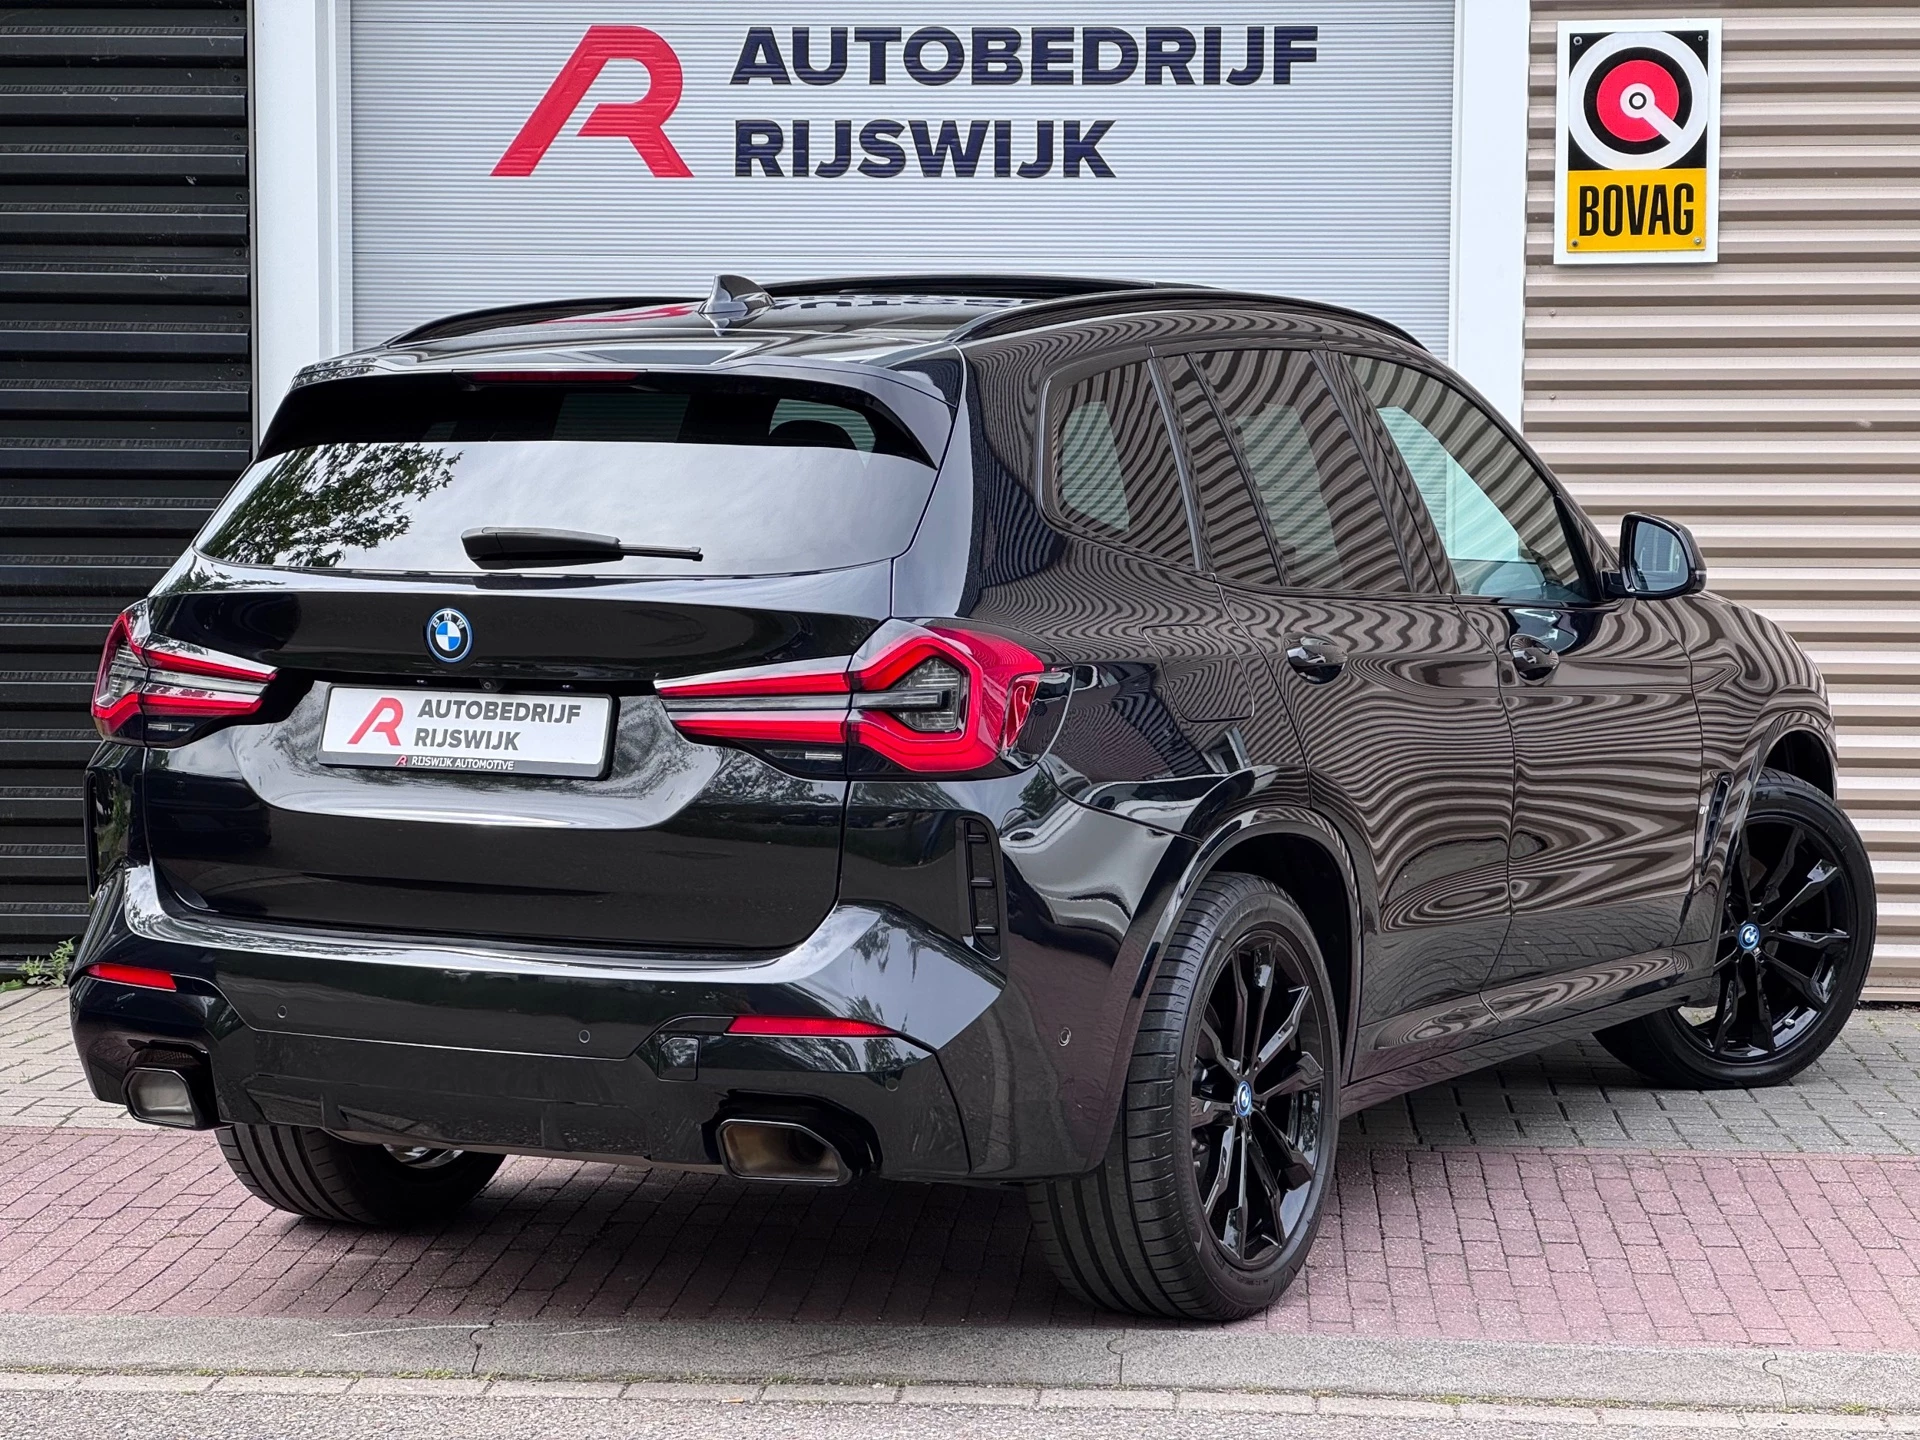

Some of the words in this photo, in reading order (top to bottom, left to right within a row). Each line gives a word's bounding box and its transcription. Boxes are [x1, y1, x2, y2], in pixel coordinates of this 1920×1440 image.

[731, 25, 1319, 86] AUTOBEDRIJF
[735, 119, 1117, 178] RIJSWIJK
[1579, 183, 1694, 236] BOVAG
[432, 612, 465, 630] BMW
[417, 698, 582, 724] AUTOBEDRIJF
[413, 727, 522, 751] RIJSWIJK
[411, 755, 453, 768] RIJSWIJK
[455, 759, 515, 771] AUTOMOTIVE
